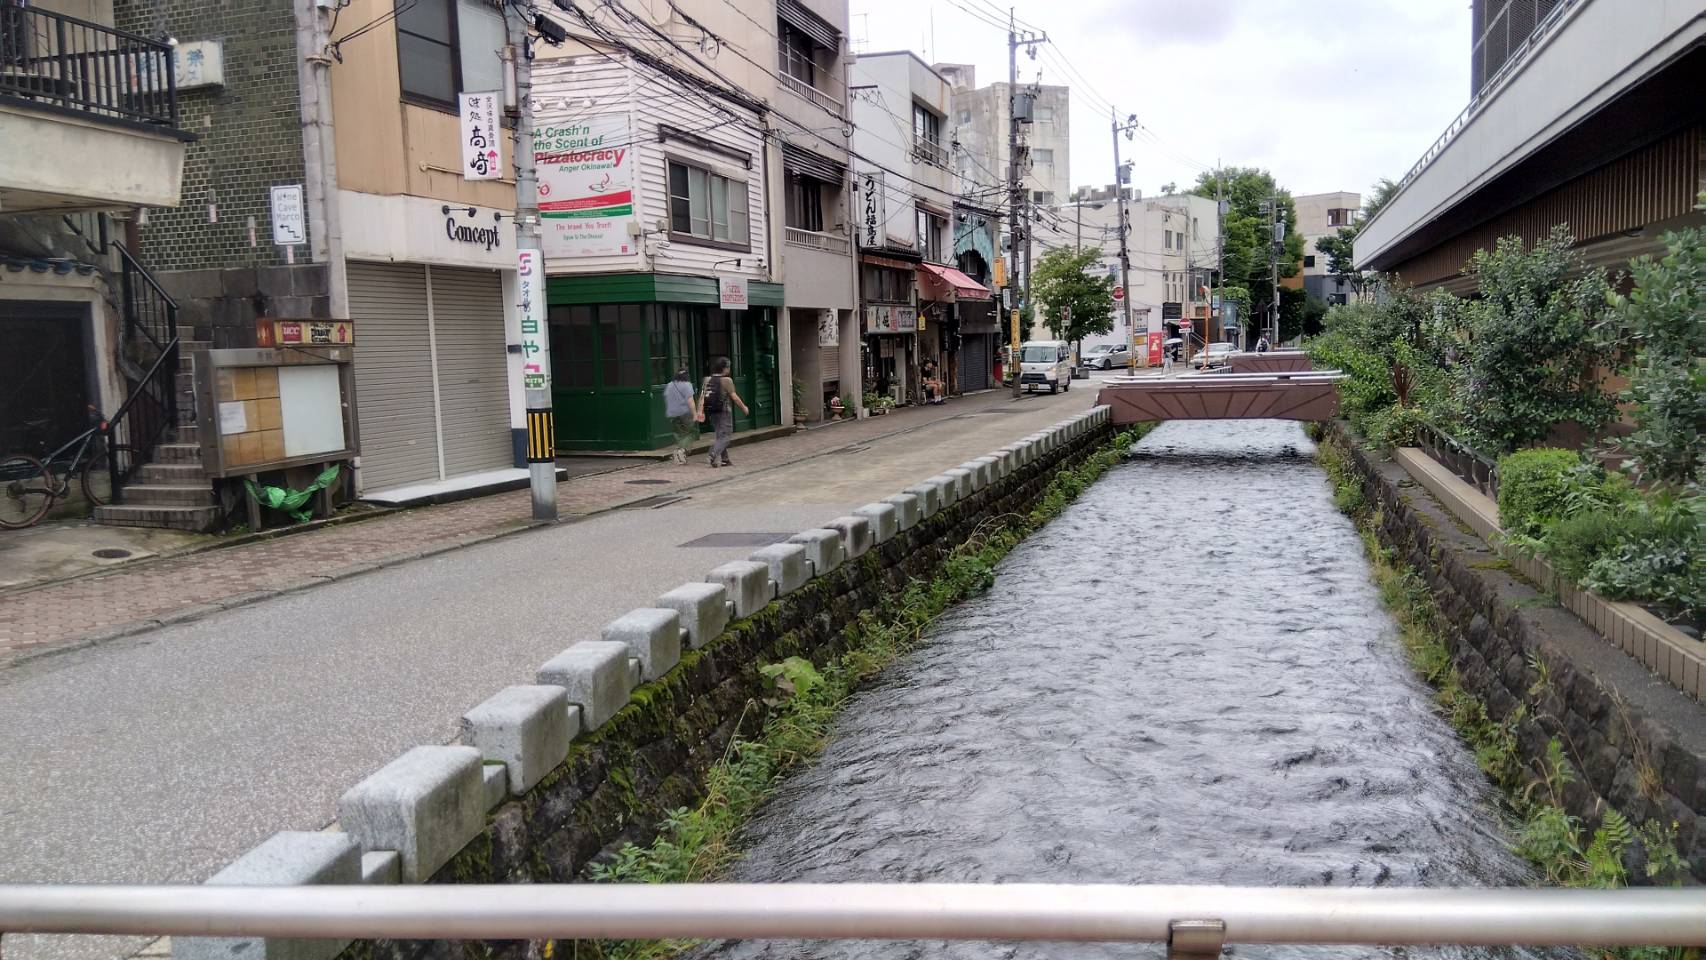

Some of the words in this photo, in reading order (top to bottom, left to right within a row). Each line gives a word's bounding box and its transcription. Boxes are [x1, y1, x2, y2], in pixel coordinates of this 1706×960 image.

[534, 128, 542, 138] A
[545, 125, 590, 138] Crash'n
[534, 140, 552, 151] the
[555, 138, 588, 149] Scent
[591, 135, 604, 146] of
[534, 148, 625, 168] Pizzatocracy
[559, 164, 580, 173] Anger
[277, 193, 298, 202] Wine
[278, 203, 298, 212] Cave
[446, 217, 500, 251] Concept
[283, 326, 300, 335] UCC
